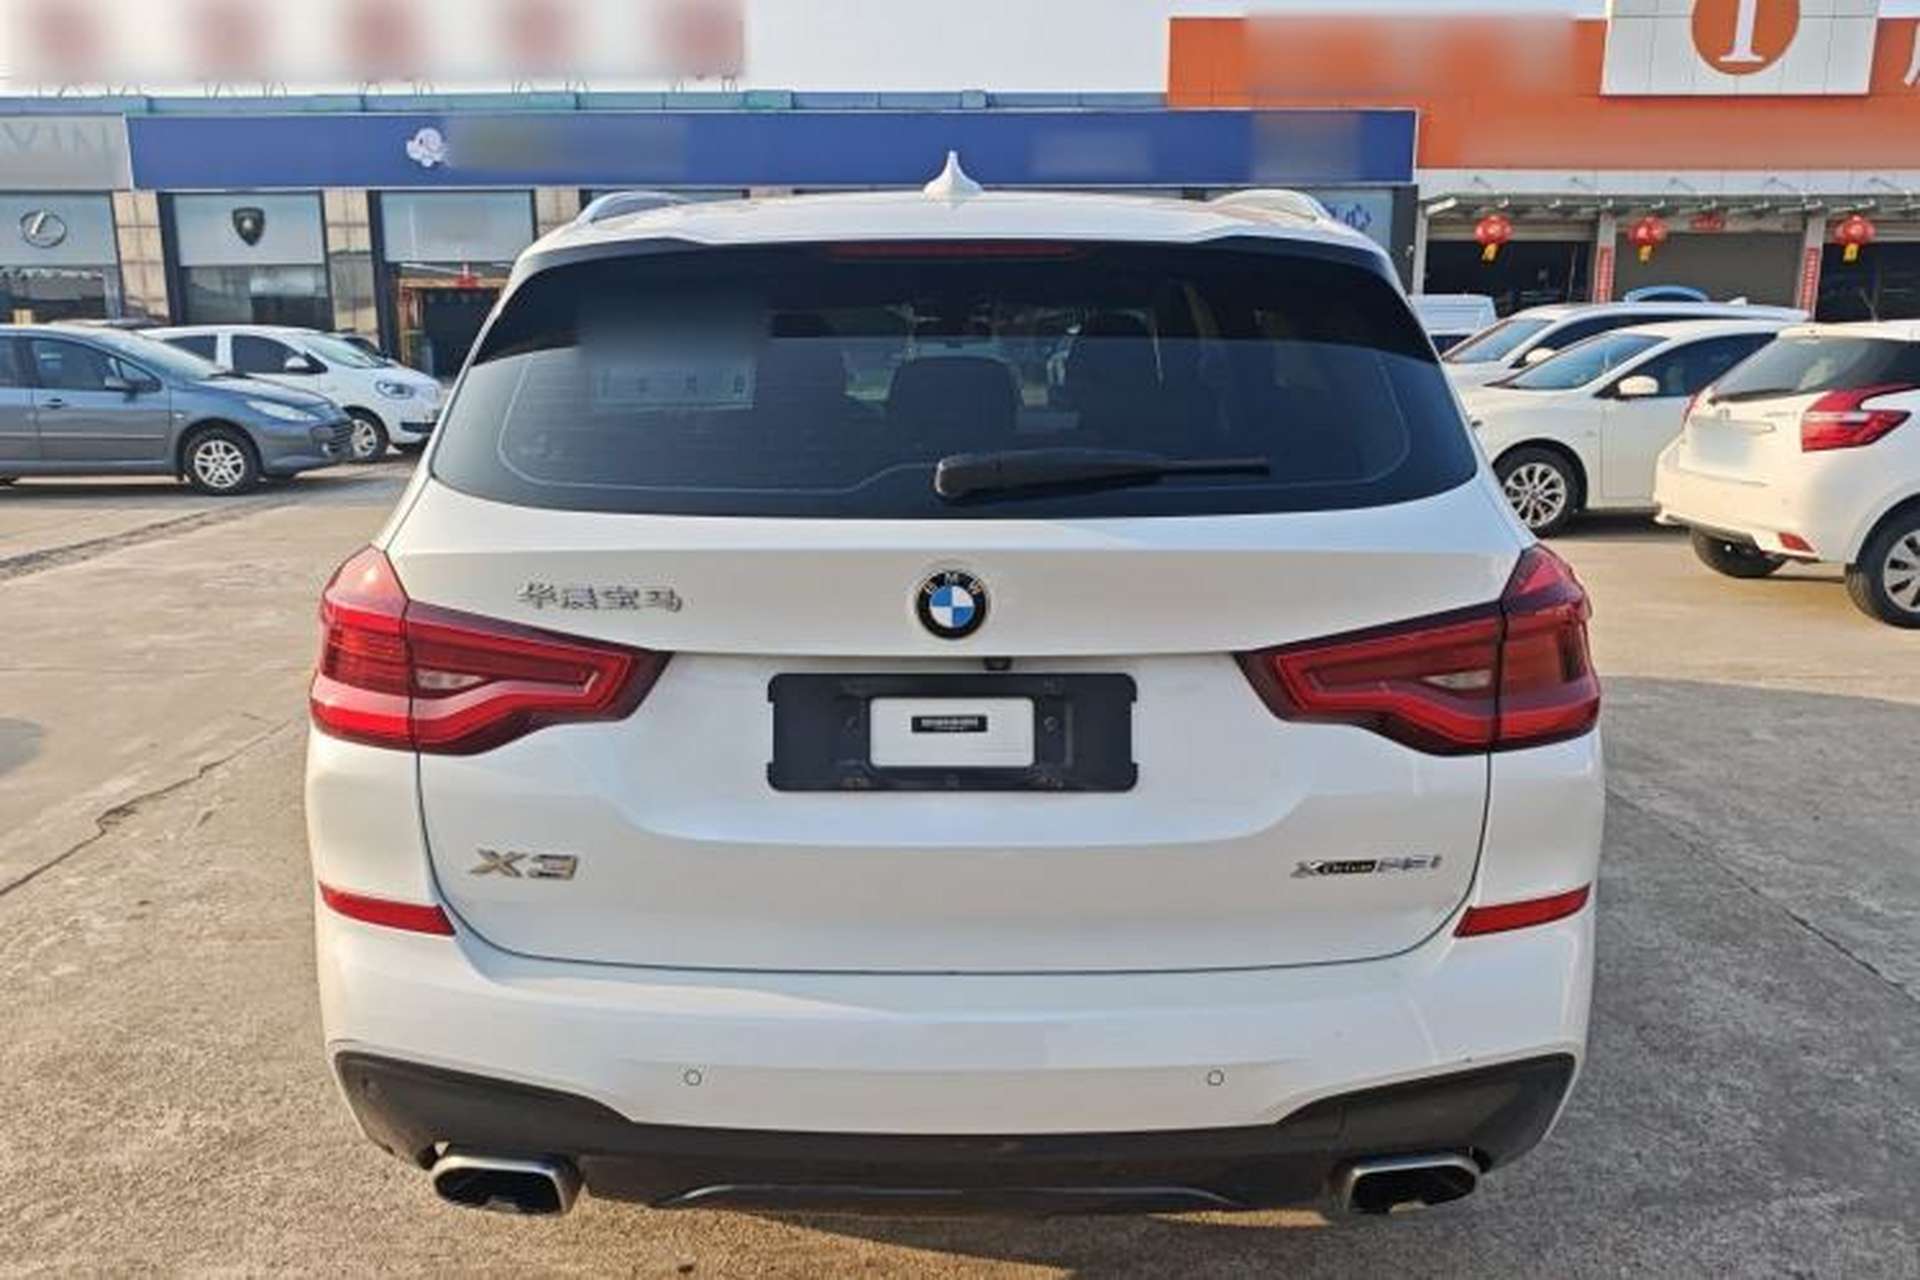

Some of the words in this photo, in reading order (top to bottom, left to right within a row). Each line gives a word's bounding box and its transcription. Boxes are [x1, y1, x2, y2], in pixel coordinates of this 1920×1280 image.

[920, 571, 984, 594] BMW
[517, 583, 683, 613] 华晨宝马
[469, 847, 578, 880] X3
